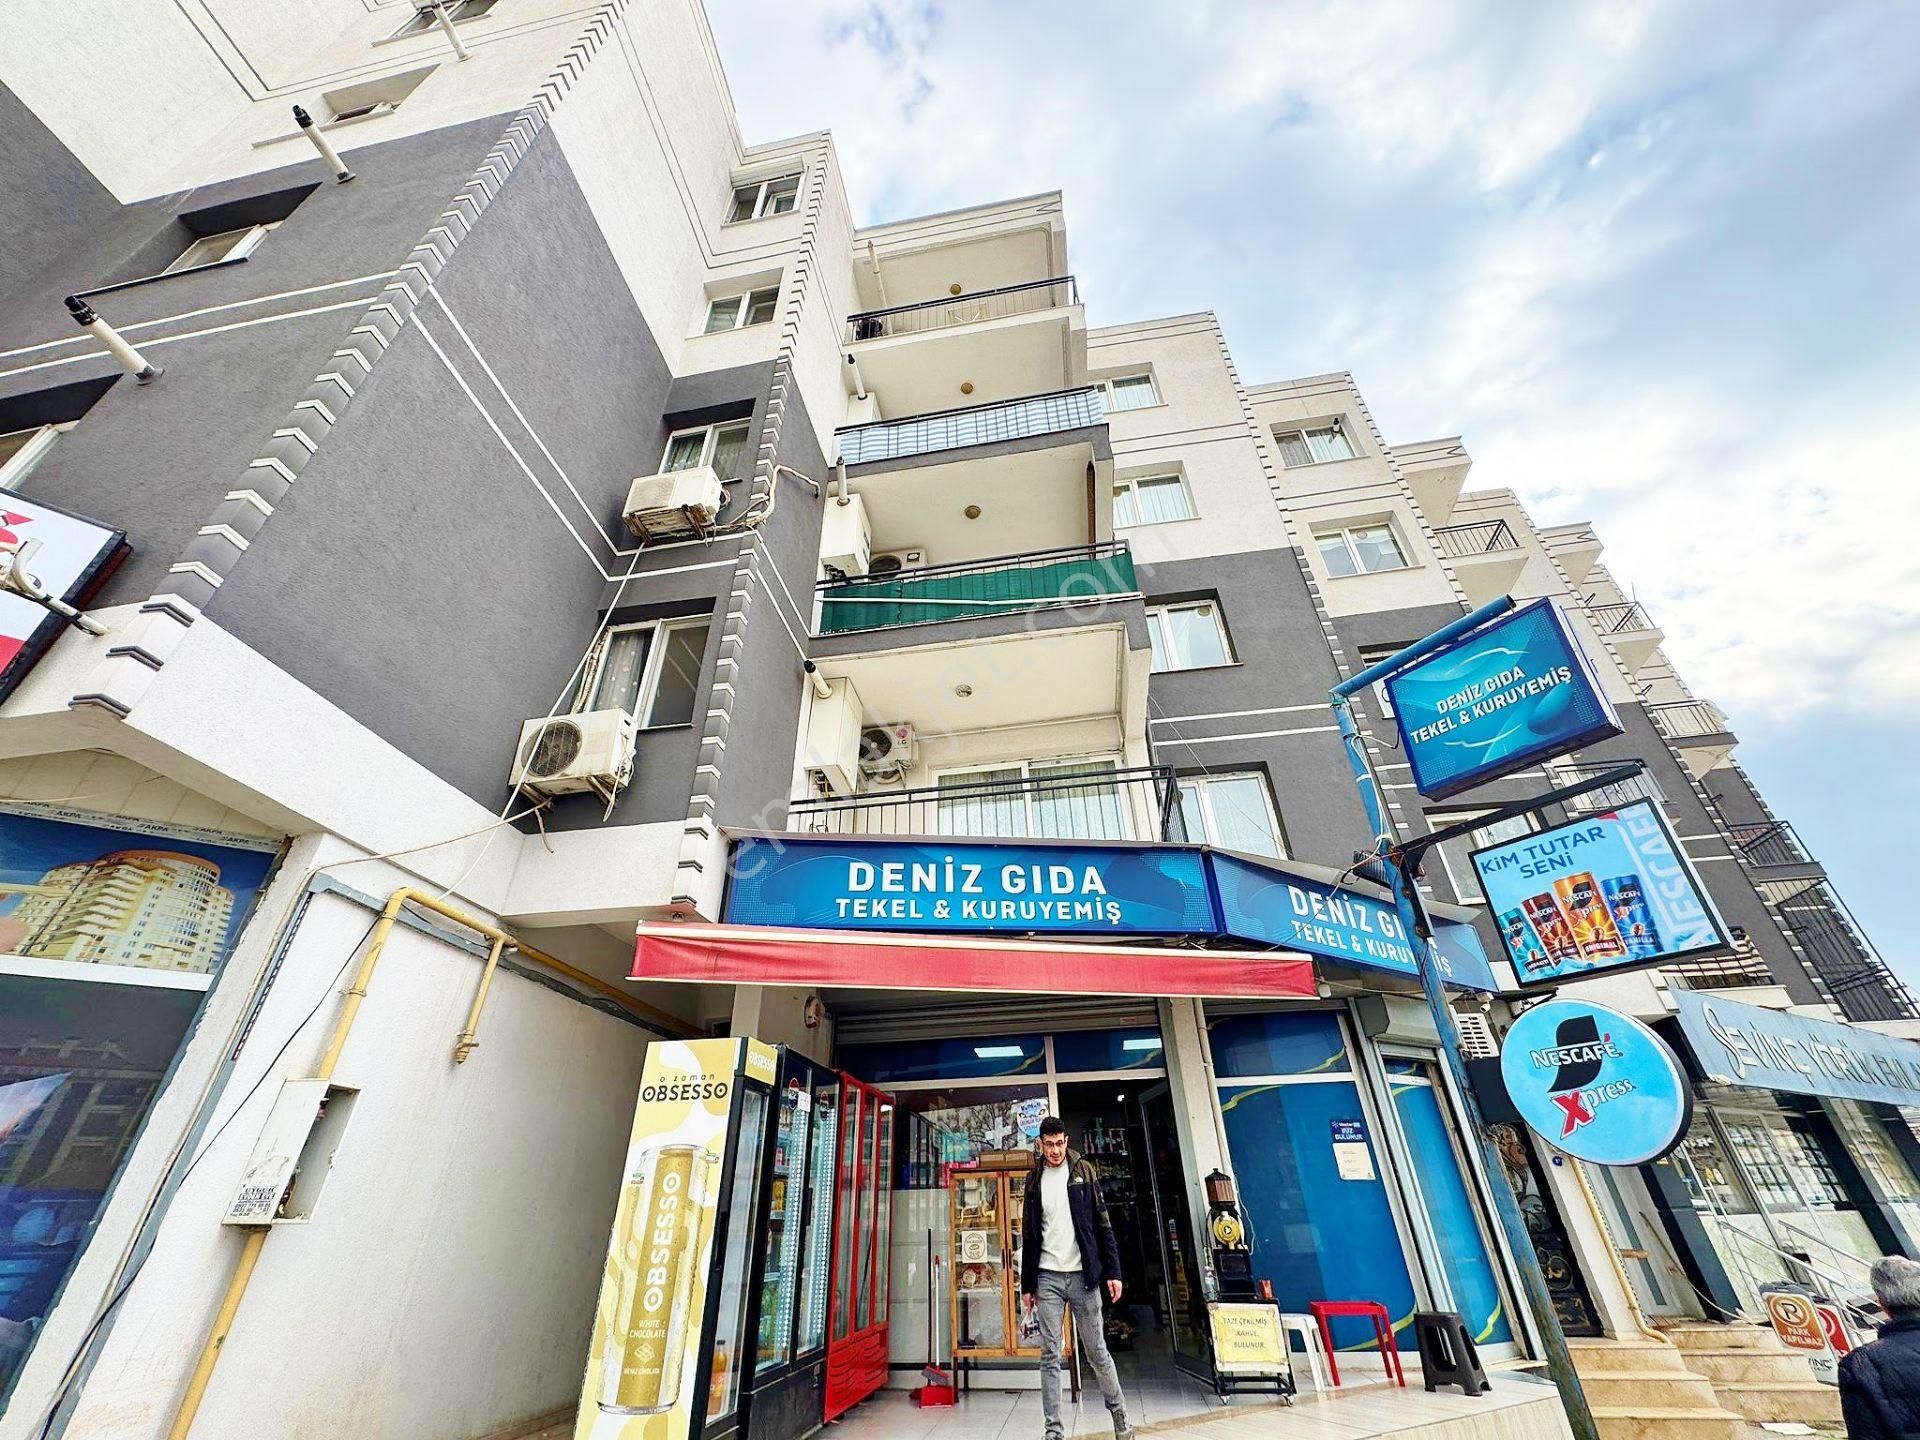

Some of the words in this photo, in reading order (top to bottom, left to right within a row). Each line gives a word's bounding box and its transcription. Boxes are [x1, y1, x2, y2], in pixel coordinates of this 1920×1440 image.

[1410, 719, 1458, 745] TEKEL
[1459, 710, 1472, 724] &
[1473, 666, 1573, 718] KURUYEMİŞ
[1436, 685, 1485, 714] DENİZ
[1484, 666, 1527, 692] GIDA
[1522, 826, 1606, 857] TUTAR
[848, 855, 984, 894] DENİZ
[1001, 865, 1107, 895] GIDA
[836, 898, 923, 919] TEKEL
[933, 900, 951, 919] &
[962, 896, 1122, 925] KURUYEMİŞ
[1288, 885, 1374, 933] DENİZ
[1291, 920, 1348, 950] TEKEL
[1352, 935, 1364, 953] &
[1530, 1032, 1621, 1069] NESCAFÉ
[642, 1082, 729, 1102] OBSESSO
[1550, 1079, 1634, 1140] Xpress
[643, 1172, 682, 1313] OBSESSO
[629, 1329, 667, 1338] CHOCOLATE
[639, 1319, 660, 1329] WHITE
